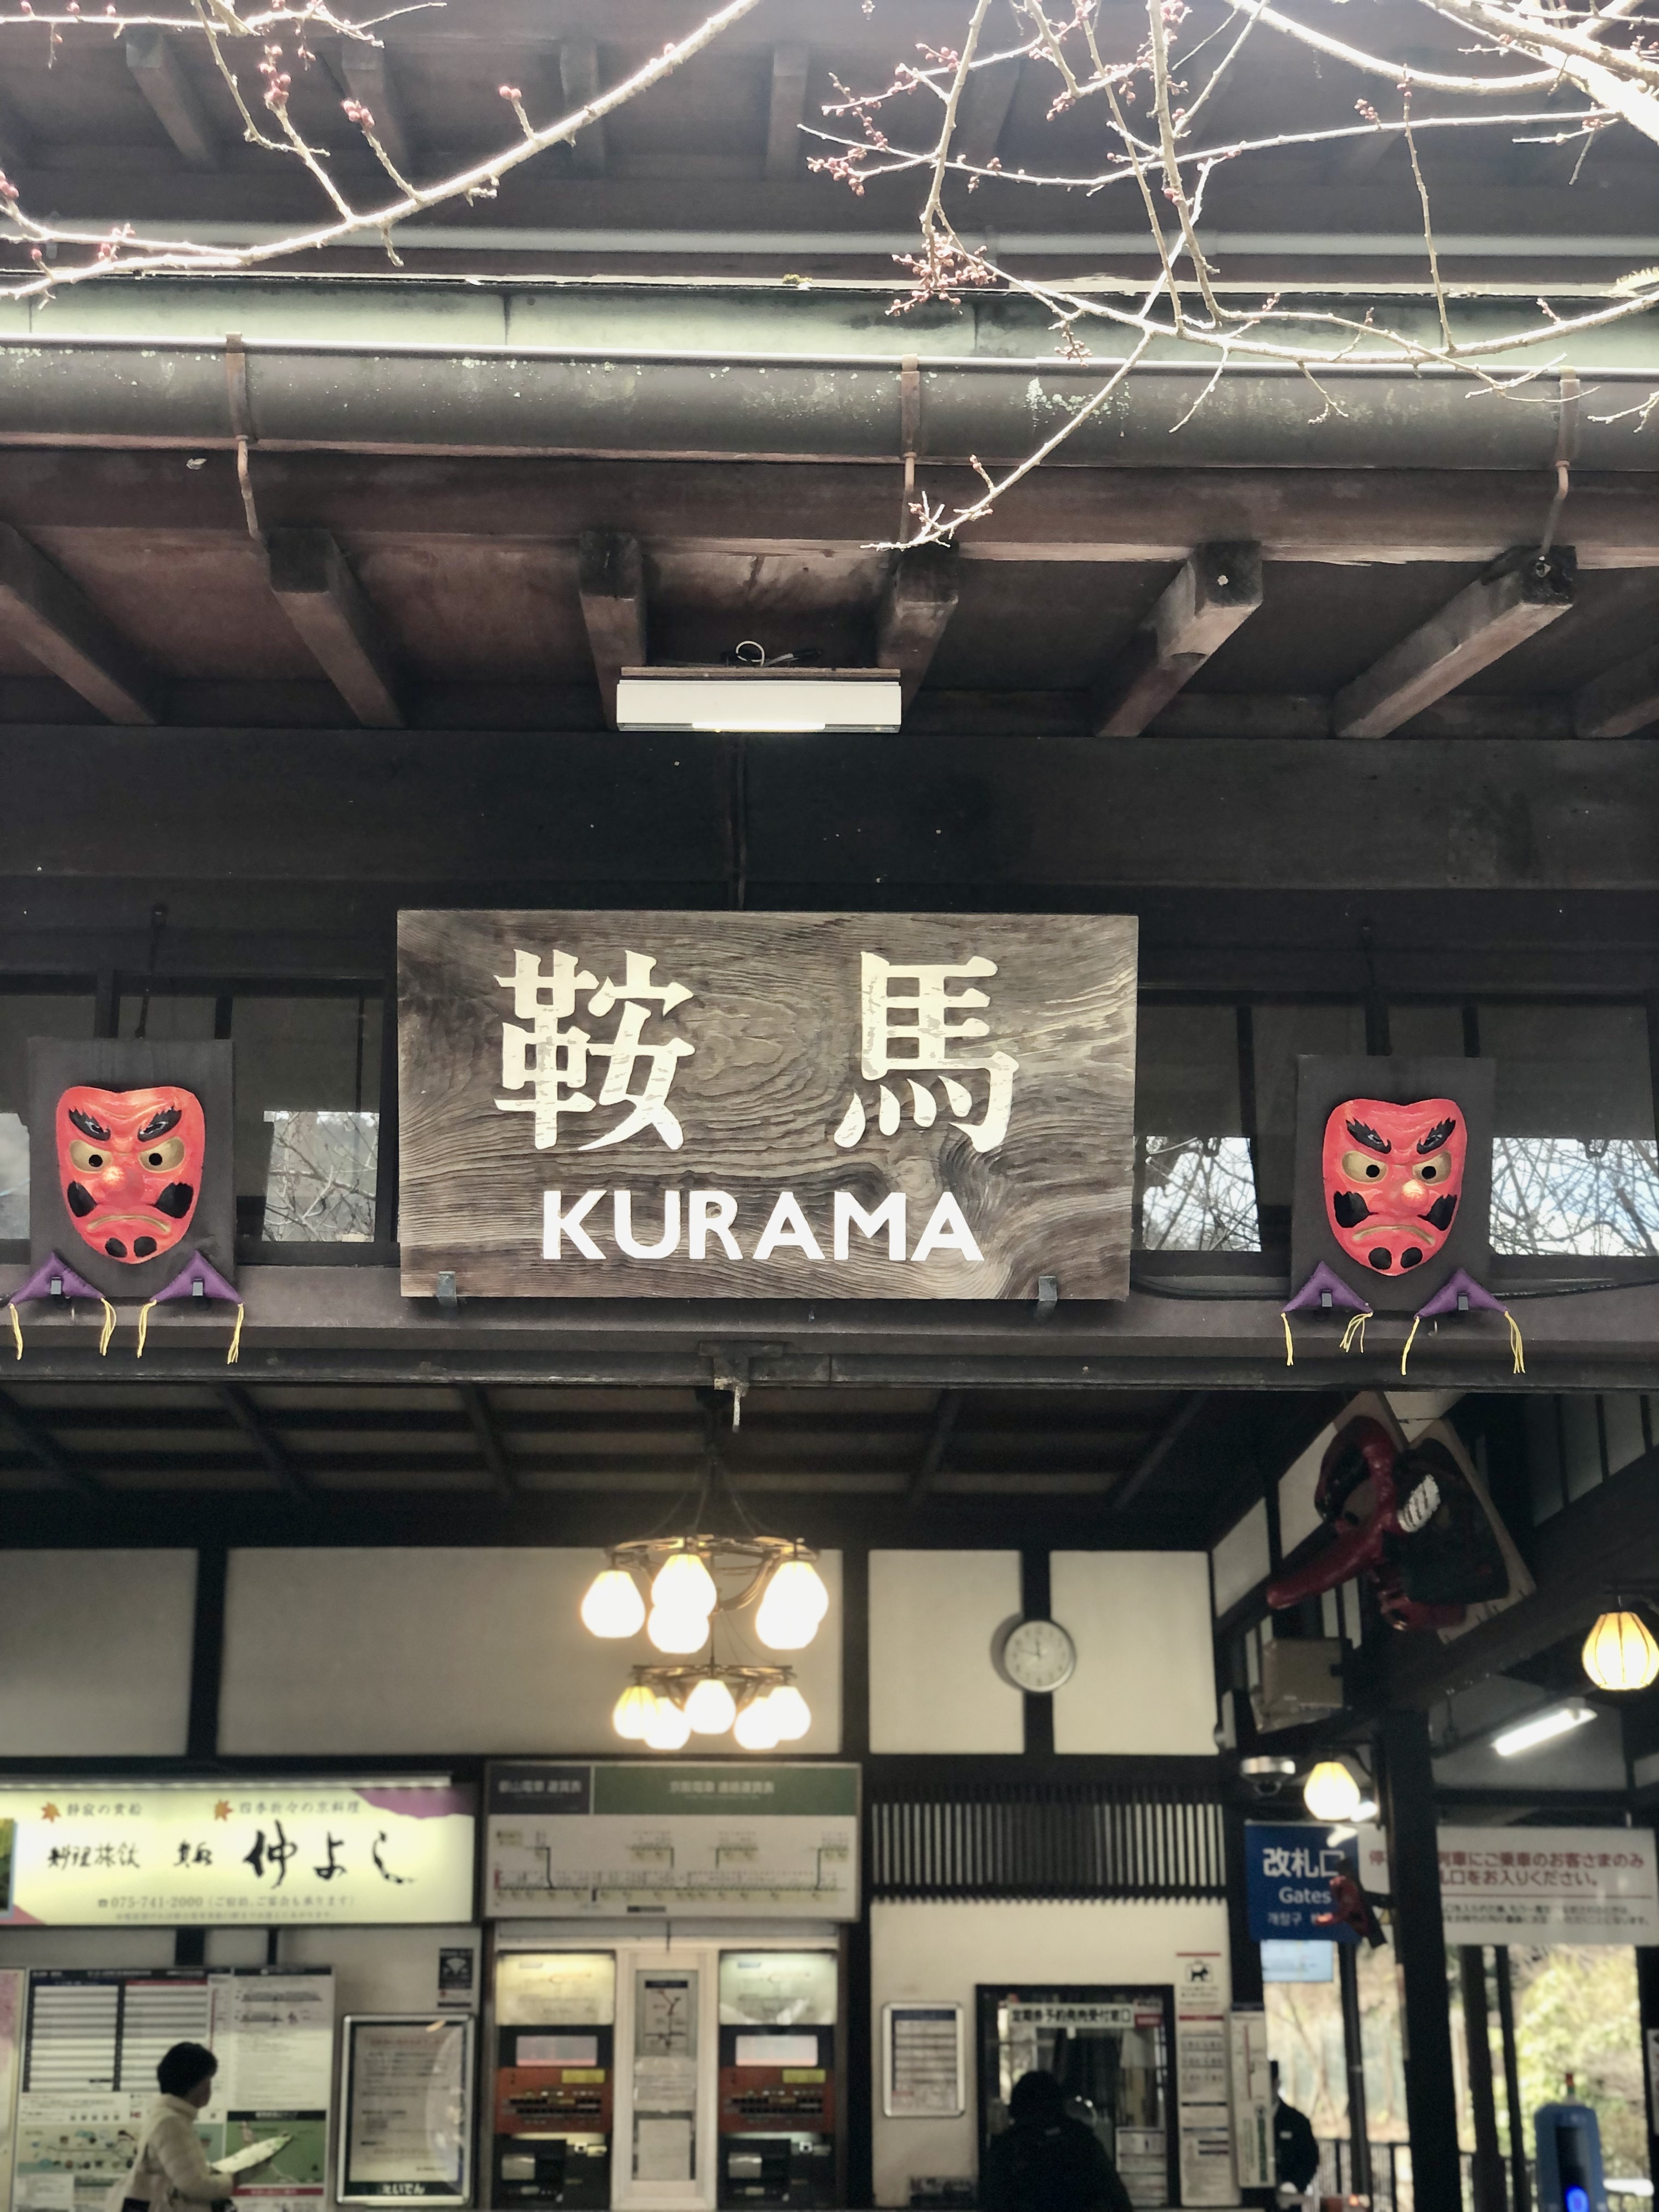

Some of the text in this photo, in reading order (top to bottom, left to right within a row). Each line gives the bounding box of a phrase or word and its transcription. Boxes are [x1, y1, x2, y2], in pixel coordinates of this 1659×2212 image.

[494, 949, 1019, 1153] 鞍馬
[541, 1190, 984, 1262] KURAMA
[242, 1819, 418, 1890] 仲よし
[1262, 1847, 1345, 1878] 改札口
[1278, 1886, 1332, 1904] Gates
